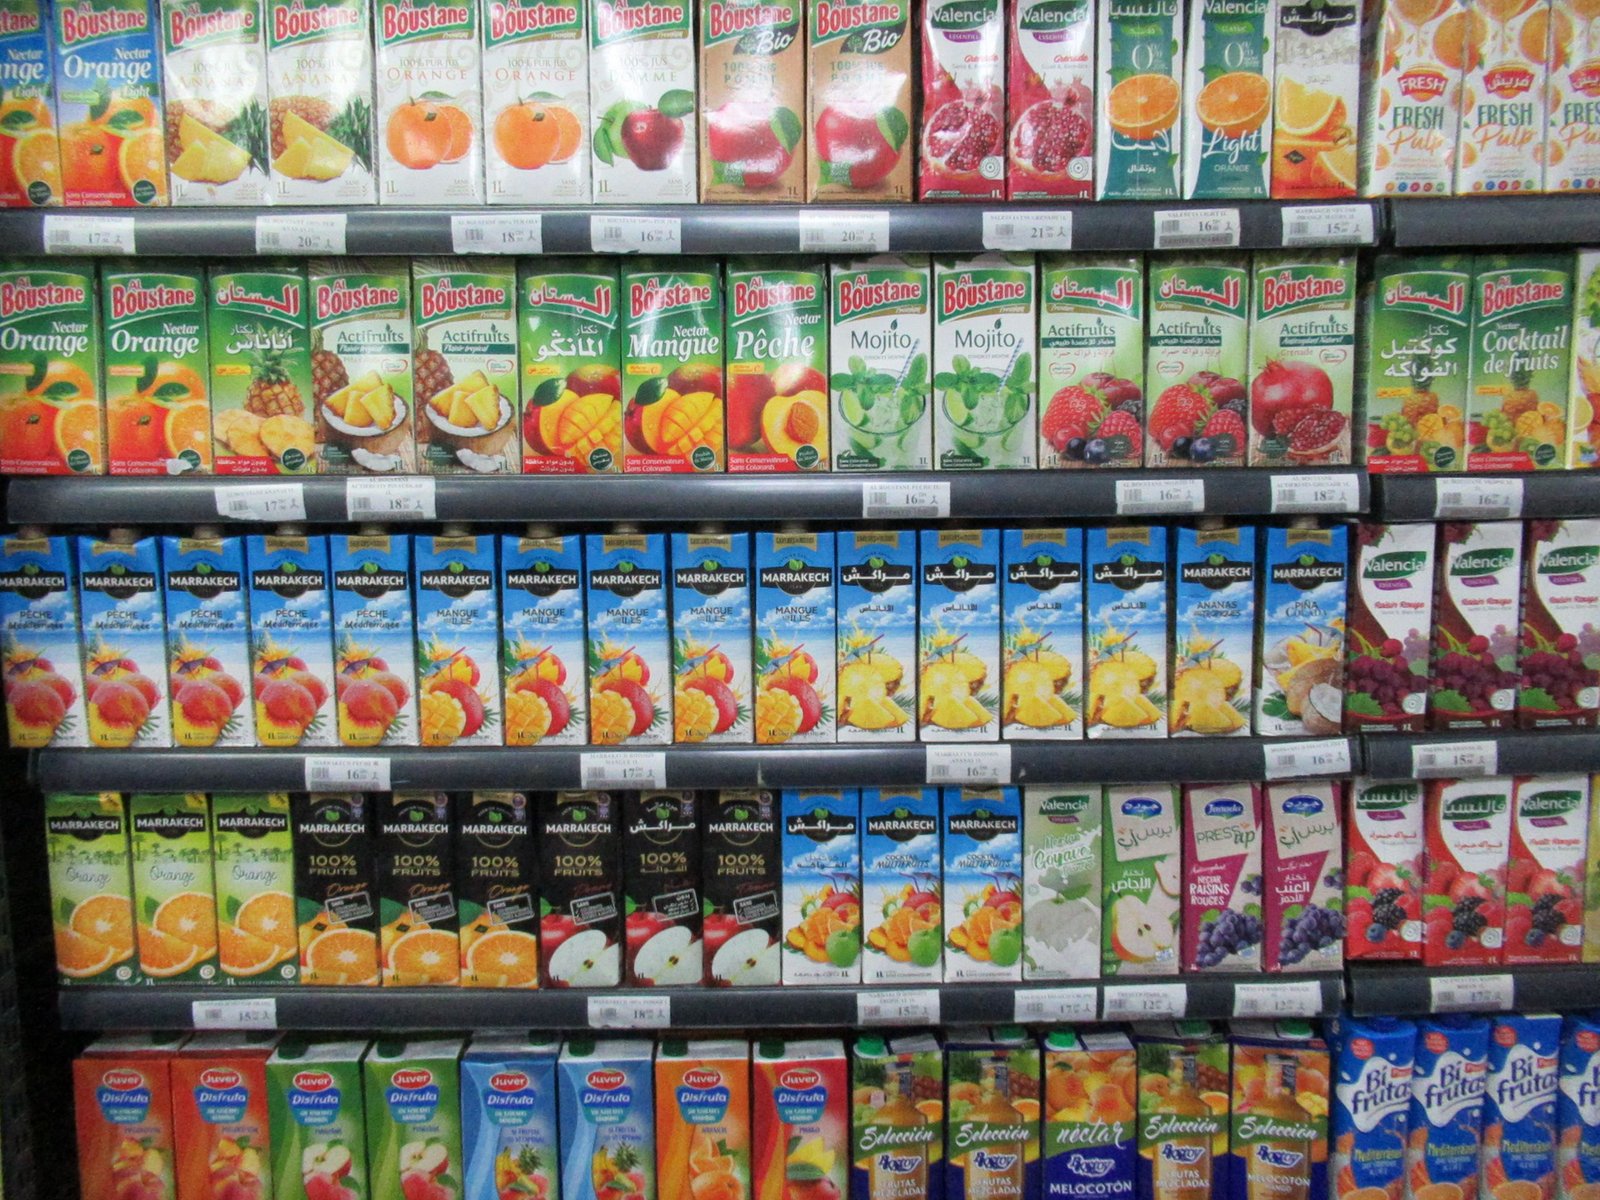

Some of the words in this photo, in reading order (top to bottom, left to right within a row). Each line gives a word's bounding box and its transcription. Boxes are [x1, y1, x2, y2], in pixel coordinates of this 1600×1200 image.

[1021, 7, 1087, 23] Valencia
[755, 29, 792, 53] Bio
[864, 29, 900, 52] Bio
[64, 55, 151, 80] Orange
[387, 68, 467, 81] ORANGE
[496, 69, 576, 81] ORANGE
[1401, 78, 1446, 92] FRESH
[1393, 106, 1444, 129] FRESH
[1478, 103, 1533, 126] FRESH
[1564, 101, 1600, 126] FRES
[1387, 124, 1446, 154] Pulp
[1203, 128, 1260, 163] Light
[842, 231, 855, 242] 20
[1031, 227, 1044, 239] 21
[216, 281, 299, 316] البستان
[734, 282, 815, 316] Boustane
[839, 280, 920, 315] Boustane
[944, 279, 1025, 315] Boustane
[1264, 276, 1345, 311] Boustane
[1482, 281, 1563, 316] Boustane
[112, 284, 195, 319] Boustane
[316, 284, 398, 319] Boustane
[421, 284, 504, 319] Boustane
[162, 322, 198, 336] Nectar
[1281, 321, 1348, 335] Actifruits
[2, 327, 88, 358] Orange
[112, 328, 199, 358] Orange
[734, 328, 815, 360] Pêche
[851, 330, 912, 354] Mojito
[955, 329, 1015, 353] Mojito
[1483, 325, 1568, 352] Cocktail
[627, 333, 719, 362] Mangue
[1381, 338, 1457, 359] كوكتيل
[1484, 358, 1503, 374] de
[1505, 351, 1559, 377] fruits
[1160, 489, 1172, 500] 16
[1314, 490, 1326, 501] 18
[389, 499, 402, 510] 18
[1366, 557, 1427, 573] Valencia
[1451, 555, 1514, 570] Valencia
[677, 573, 744, 584] MARRAKECH
[762, 572, 830, 584] MARRAKECH
[842, 567, 911, 583] مراكش
[1184, 566, 1251, 579] MARRAKECH
[1273, 568, 1343, 579] MARRAKECH
[0, 575, 65, 587] MARRAKECH
[85, 576, 154, 587] MARRAKECH
[170, 575, 238, 587] MARRAKECH
[255, 574, 322, 586] MARRAKECH
[337, 575, 404, 586] MARRAKECH
[422, 575, 490, 586] MARRAKECH
[508, 574, 577, 586] MARRAKECH
[592, 574, 660, 585] MARRAKECH
[1197, 600, 1237, 609] ANANAS
[1295, 599, 1318, 609] PIÑA
[190, 608, 223, 619] PÊCHE
[437, 608, 479, 618] MANGUE
[522, 607, 565, 617] MANGUE
[606, 608, 649, 617] MANGUE
[690, 607, 733, 616] MANGUE
[775, 606, 818, 615] MANGUE
[1453, 755, 1466, 765] 15
[346, 769, 360, 780] 16
[622, 768, 635, 778] 17
[967, 767, 979, 777] 16
[1039, 800, 1089, 811] Valencia
[1521, 797, 1581, 811] Valencia
[51, 819, 120, 831] MARRAKECH
[136, 818, 203, 828] MARRAKECH
[219, 817, 285, 828] MARRAKECH
[546, 824, 611, 833] MARRAKECH
[709, 823, 774, 833] MARRAKECH
[869, 820, 934, 831] MARRAKECH
[950, 820, 1016, 831] MARRAKECH
[300, 824, 365, 834] MARRAKECH
[383, 824, 449, 834] MARRAKECH
[462, 825, 527, 835] MARRAKECH
[1196, 825, 1240, 844] PRESS
[1234, 831, 1255, 848] up
[310, 855, 357, 867] 100%
[394, 855, 440, 867] 100%
[472, 856, 519, 868] 100%
[556, 855, 602, 867] 100%
[640, 852, 687, 864] 100%
[718, 854, 765, 866] 100%
[309, 868, 357, 876] FRUITS
[392, 868, 441, 877] FRUITS
[471, 869, 520, 877] FRUITS
[554, 868, 602, 877] FRUITS
[717, 867, 766, 876] FRUITS
[1190, 883, 1230, 895] RAISINS
[1190, 896, 1225, 905] ROUGES
[1440, 1060, 1462, 1088] Bi
[1511, 1056, 1533, 1083] Bi
[105, 1074, 141, 1086] Juver
[204, 1073, 238, 1085] Juver
[297, 1075, 330, 1086] Juver
[395, 1073, 428, 1085] Juver
[492, 1075, 527, 1087] Juver
[589, 1073, 623, 1084] Juver
[686, 1073, 719, 1084] Juver
[784, 1073, 818, 1084] Juver
[1366, 1066, 1388, 1094] Bi
[102, 1092, 149, 1104] Disfruta
[200, 1091, 247, 1104] Disfruta
[292, 1093, 339, 1105] Disfruta
[390, 1091, 438, 1103] Disfruta
[488, 1091, 534, 1105] Disfruta
[583, 1091, 630, 1104] Disfruta
[680, 1090, 728, 1104] Disfruta
[778, 1091, 825, 1104] Disfruta
[1145, 1115, 1220, 1140] Selección
[1238, 1116, 1318, 1143] Selección
[860, 1126, 935, 1150] Selección
[956, 1123, 1030, 1146] Selección
[1057, 1121, 1127, 1150] néctar
[1050, 1180, 1132, 1195] MELOCOTÓN
